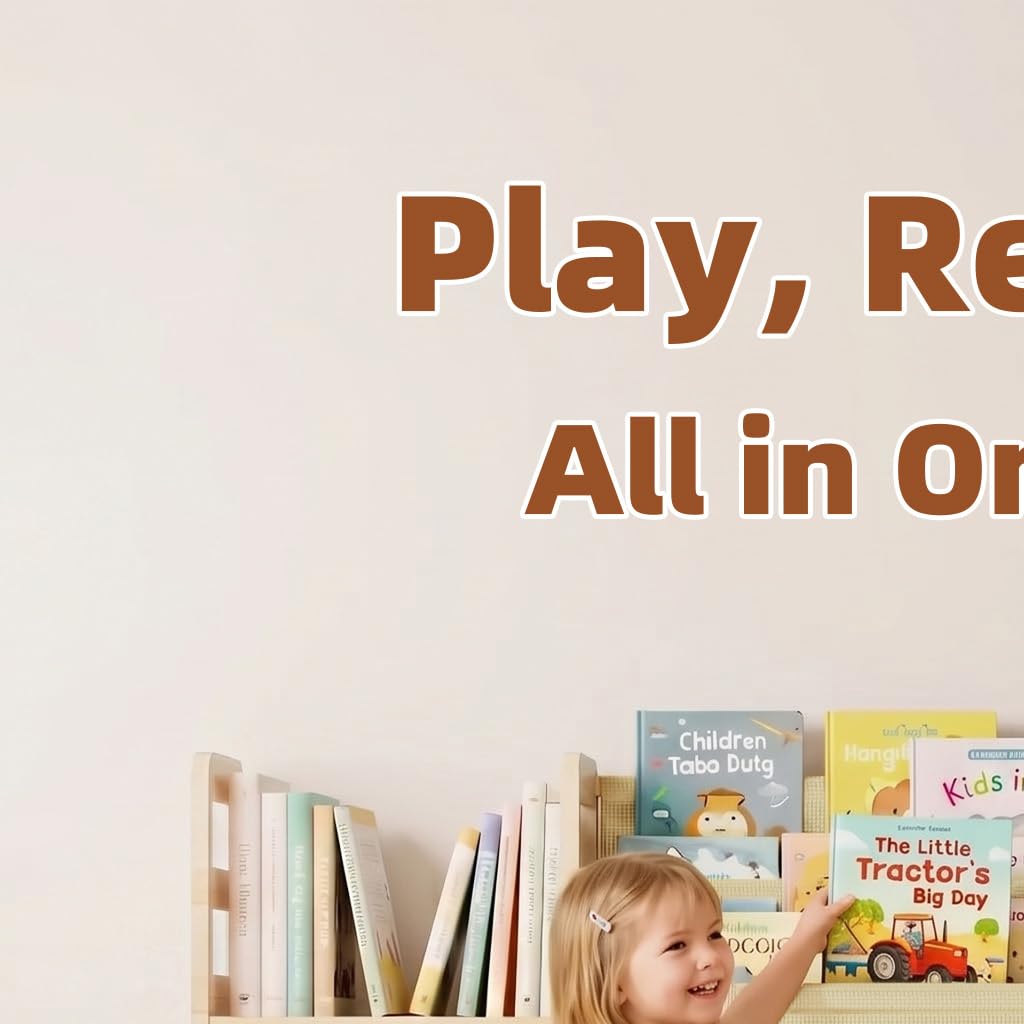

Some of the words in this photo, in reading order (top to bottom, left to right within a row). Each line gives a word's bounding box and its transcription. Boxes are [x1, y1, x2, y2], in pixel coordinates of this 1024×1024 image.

[680, 730, 767, 751] Children
[668, 755, 720, 775] Tabo
[727, 753, 774, 779] Dutg
[942, 770, 1003, 807] Kids
[875, 836, 910, 854] The
[918, 839, 972, 857] Little
[855, 857, 991, 885] Tractor's
[913, 887, 945, 909] Big
[951, 889, 989, 911] Day
